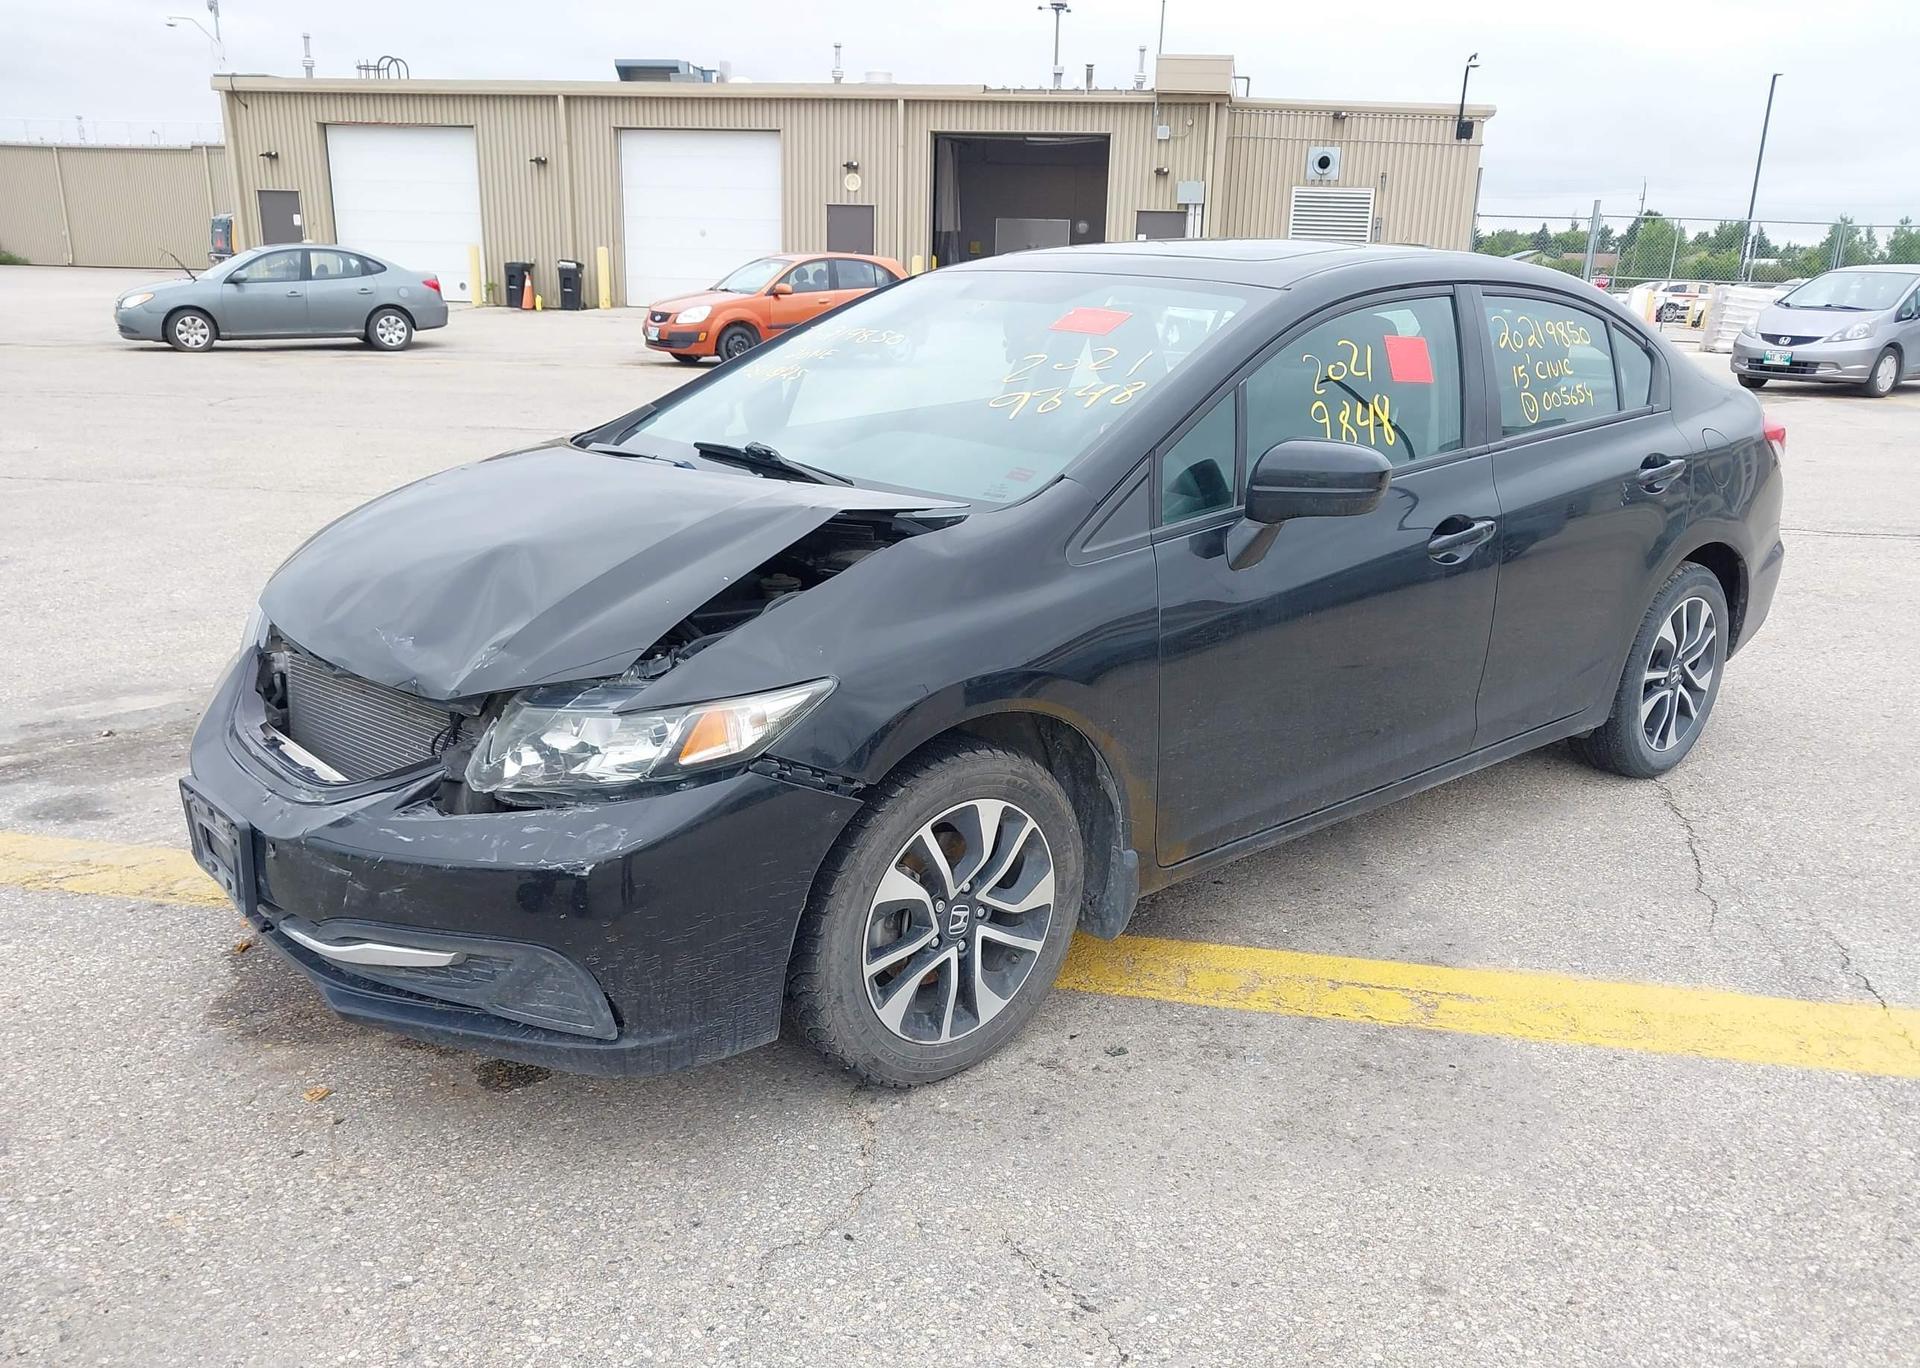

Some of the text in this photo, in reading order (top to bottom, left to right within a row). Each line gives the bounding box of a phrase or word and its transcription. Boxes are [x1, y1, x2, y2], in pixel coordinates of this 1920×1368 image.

[1491, 315, 1591, 353] 20219850
[1303, 339, 1373, 395] 2021
[1535, 358, 1574, 379] CIVIC
[1543, 381, 1594, 411] 005654
[1310, 393, 1396, 445] 9848
